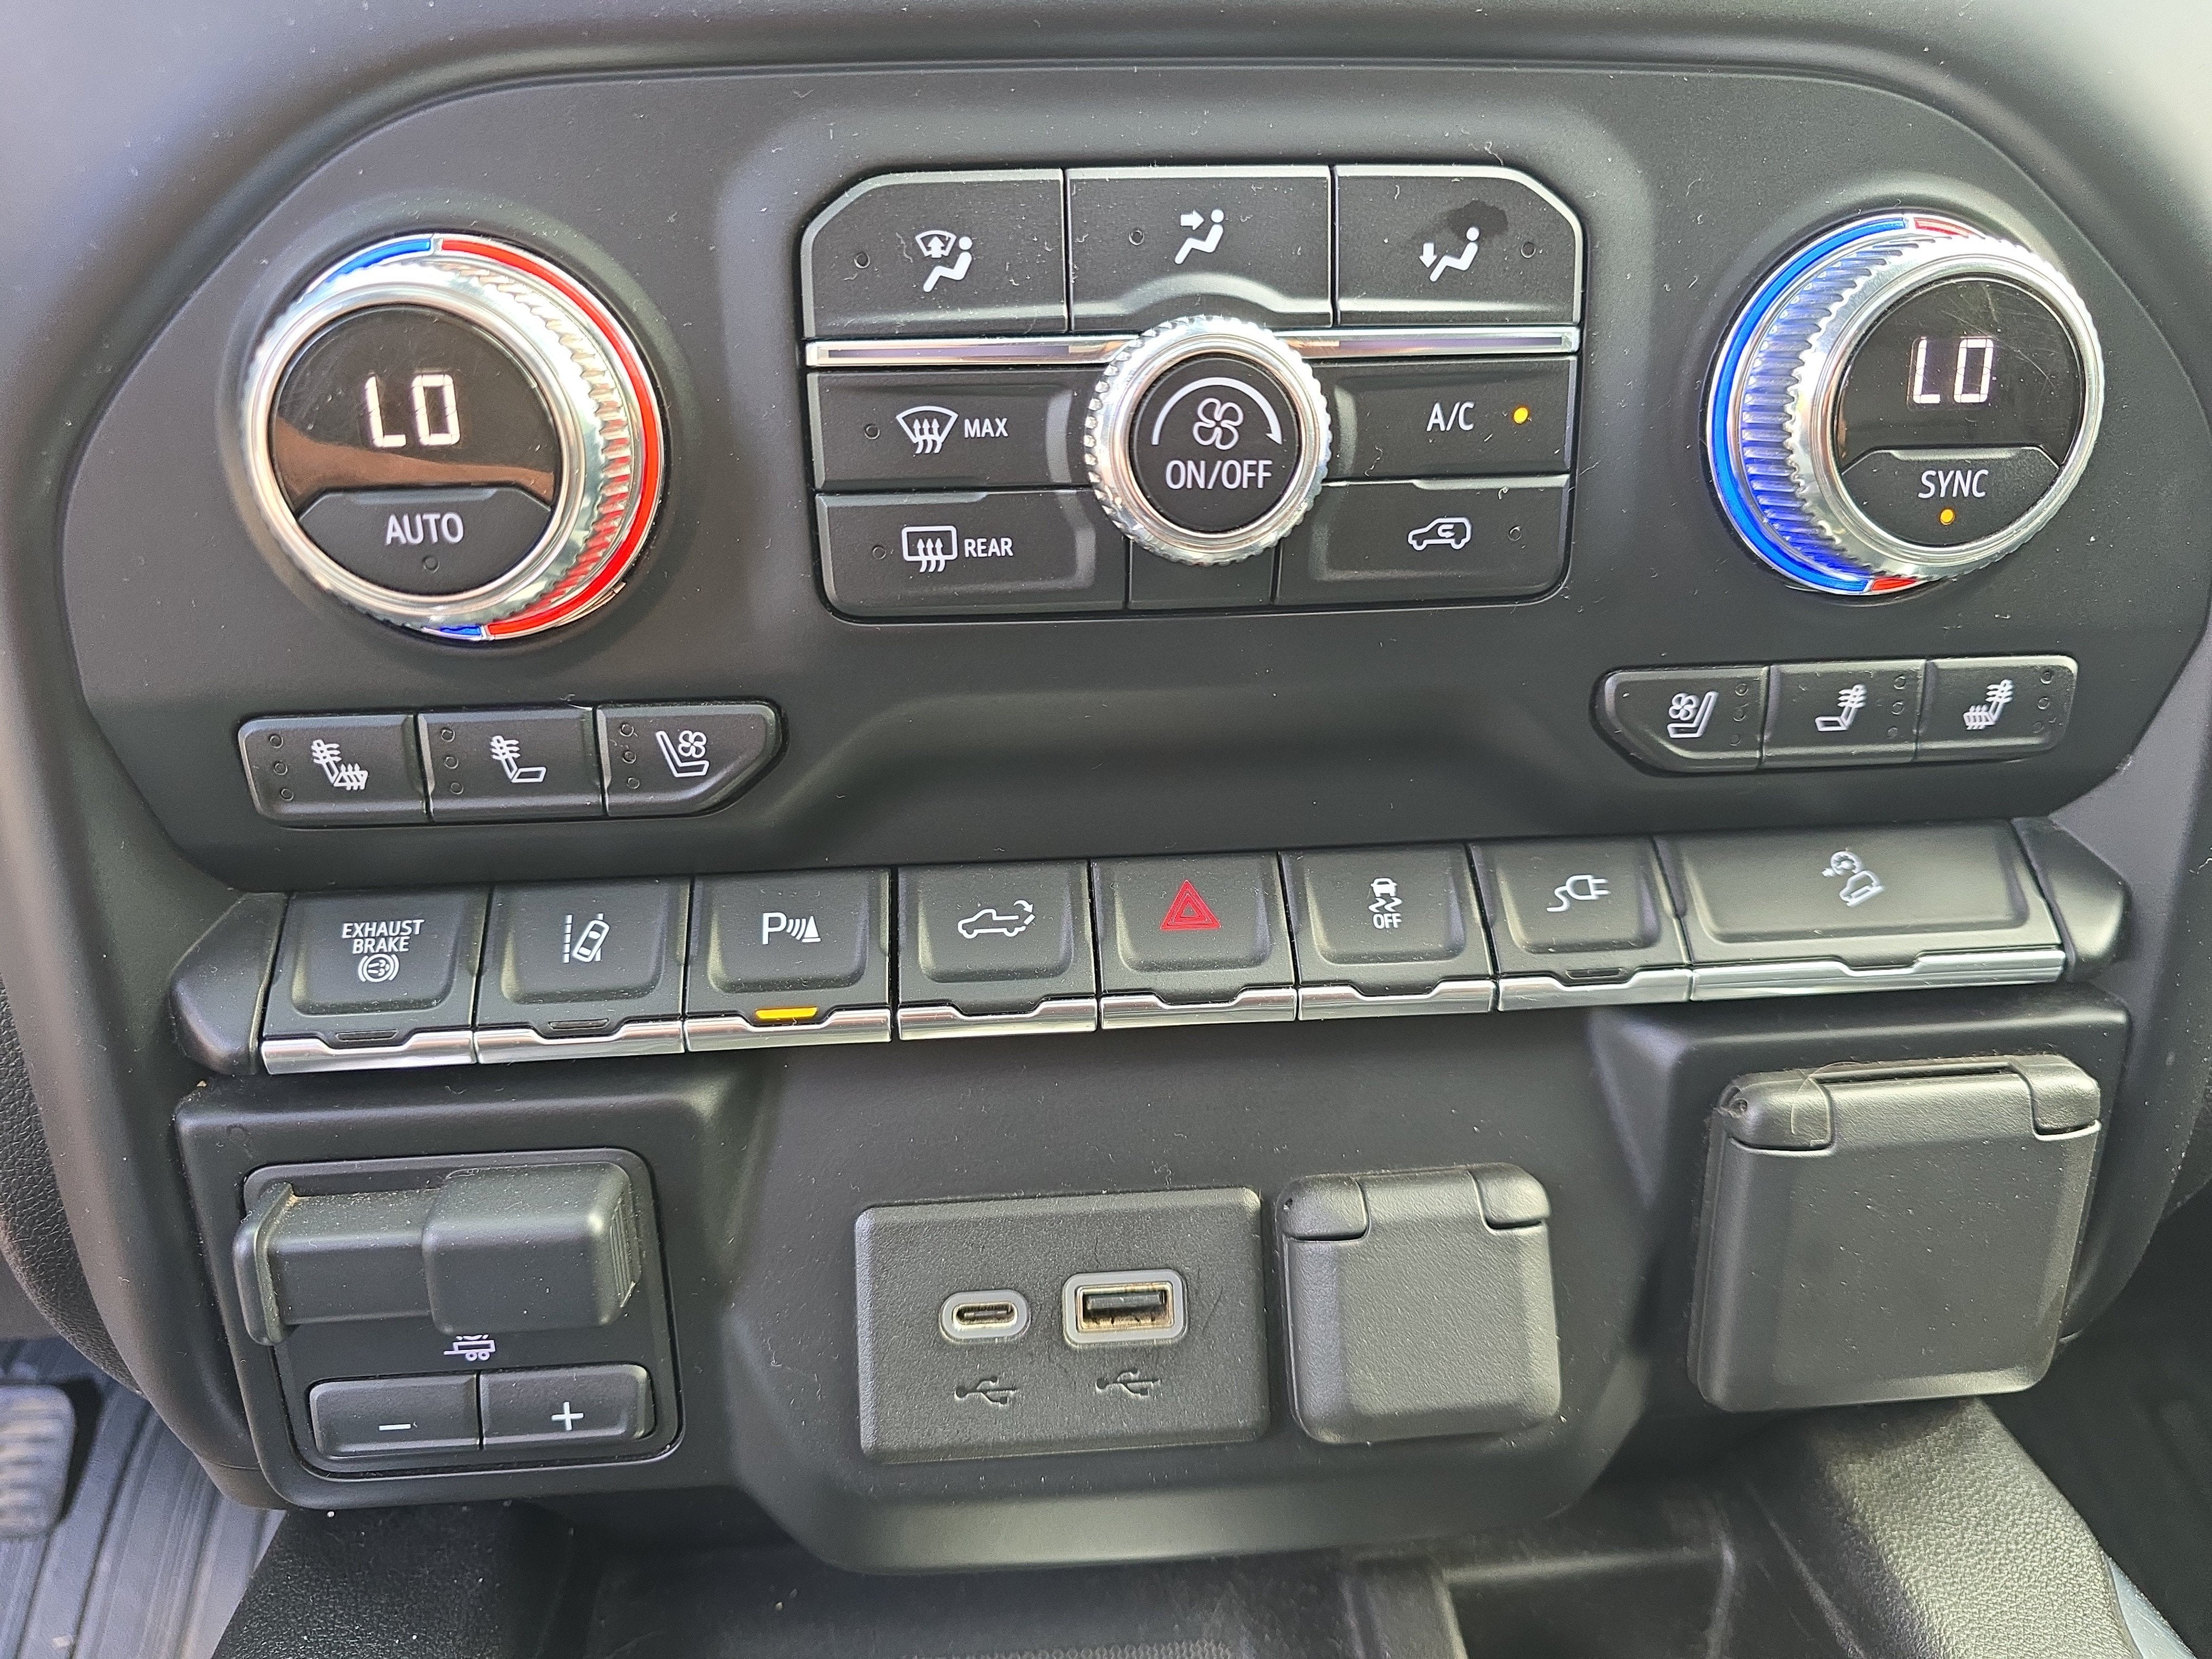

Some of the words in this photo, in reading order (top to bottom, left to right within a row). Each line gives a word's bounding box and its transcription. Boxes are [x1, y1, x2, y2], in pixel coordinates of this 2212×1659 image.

[1913, 337, 1991, 404] LO
[364, 372, 460, 448] LO
[1426, 402, 1475, 432] A/C
[964, 417, 1009, 439] MAX
[1165, 459, 1274, 491] ON/OFF
[1918, 470, 1989, 499] SYNC
[385, 512, 465, 546] AUTO
[964, 537, 1013, 558] REAR
[342, 919, 425, 939] EXHAUST
[1372, 912, 1402, 930] OFF
[352, 935, 410, 953] BRAKE
